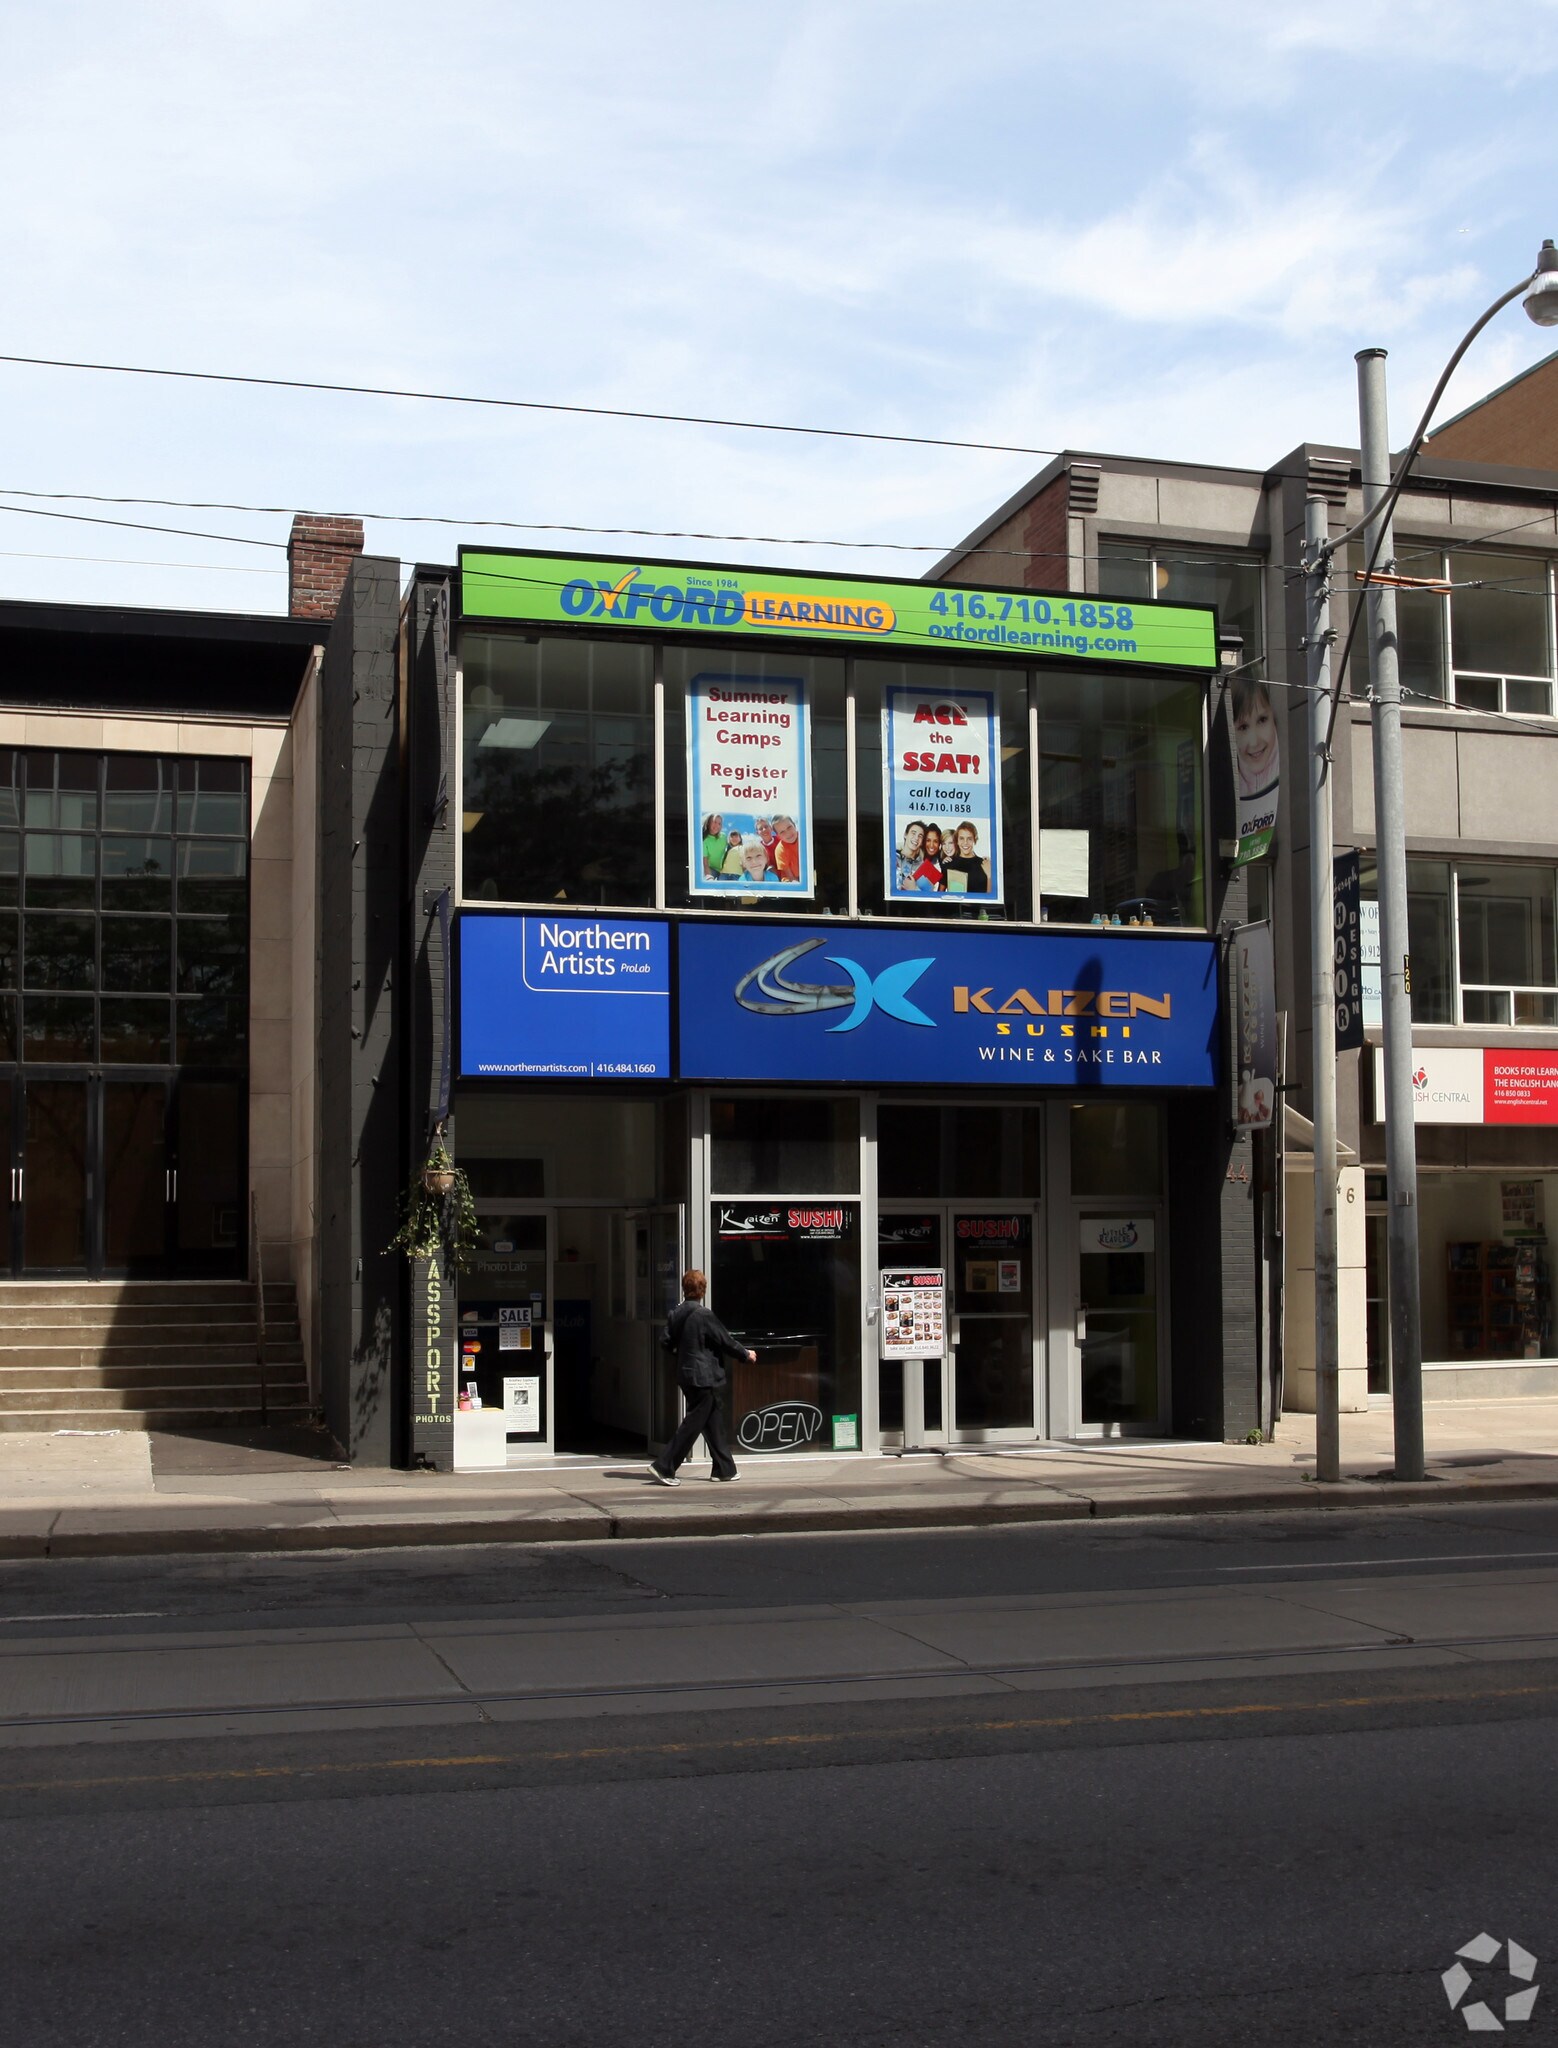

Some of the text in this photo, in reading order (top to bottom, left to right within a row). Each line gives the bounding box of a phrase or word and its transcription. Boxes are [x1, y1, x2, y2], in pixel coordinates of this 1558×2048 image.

[686, 577, 738, 588] Since 1984
[560, 567, 884, 627] OXFORD LEARNING
[929, 591, 1134, 631] 416.710.1858
[928, 622, 1137, 654] oxfordlearning.com
[709, 687, 788, 704] Summer
[706, 707, 791, 728] Learning
[913, 703, 968, 726] ACE
[716, 729, 781, 748] Camps
[929, 732, 953, 744] the
[710, 763, 788, 780] Register
[903, 751, 981, 775] SSAT!
[721, 784, 778, 802] Today!
[909, 787, 971, 803] call today
[909, 802, 971, 813] 416.710.1858
[539, 923, 651, 951] Northern
[540, 950, 651, 976] Artists ProLab
[1349, 911, 1360, 1015] DESIGN
[953, 986, 1171, 1019] KAIZEN
[996, 1023, 1130, 1038] SUSHI
[978, 1047, 1162, 1064] WINE & SAKE BAR
[478, 1062, 656, 1073] www.northernartists.com 416.484.1660
[1494, 1066, 1520, 1075] BOOKS
[1520, 1067, 1536, 1075] FOR
[1494, 1079, 1509, 1087] THE
[1509, 1079, 1541, 1088] ENGLISH
[1431, 1092, 1471, 1102] CENTRAL
[1226, 1163, 1249, 1183] 44
[788, 1207, 843, 1230] SUSHI
[956, 1217, 1020, 1240] SUSHI
[477, 1260, 528, 1272] Photo Lab
[500, 1309, 529, 1322] SALE
[415, 1415, 452, 1423] PHOTOS
[740, 1412, 816, 1443] OPEN
